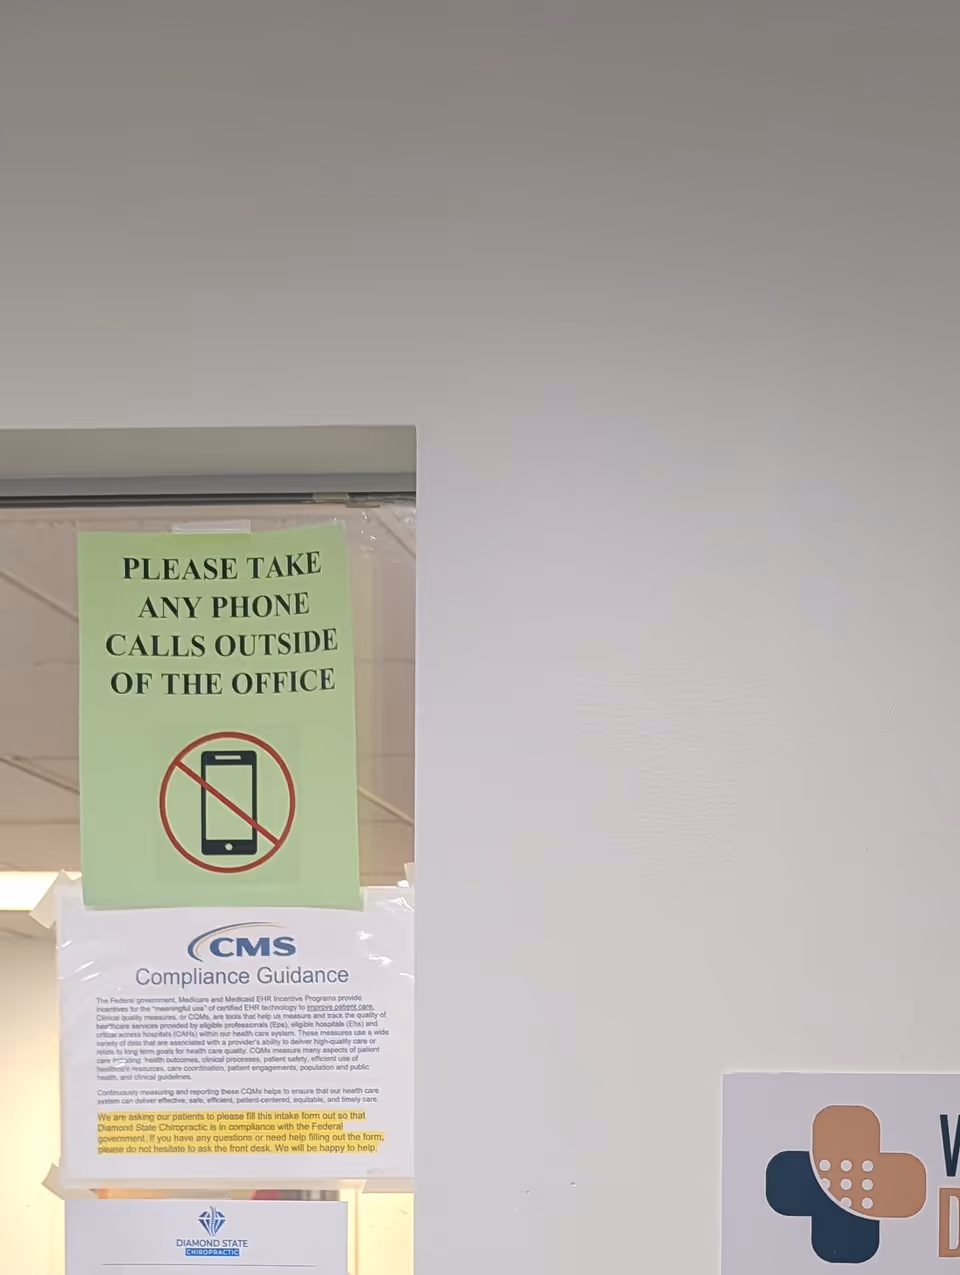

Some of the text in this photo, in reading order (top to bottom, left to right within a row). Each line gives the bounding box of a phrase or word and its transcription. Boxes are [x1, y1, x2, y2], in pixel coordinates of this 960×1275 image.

[122, 551, 322, 580] PLEASE TAKE
[138, 592, 310, 618] ANY PHONE
[106, 628, 338, 657] CALLS OUTSIDE
[110, 668, 336, 695] OF THE OFFICE
[209, 936, 296, 958] CMS
[136, 966, 349, 989] Compliance Guidance
[98, 1113, 111, 1121] We
[128, 1112, 154, 1122] asking
[172, 1112, 204, 1122] patients
[206, 1112, 214, 1120] to
[216, 1112, 244, 1122] please
[246, 1112, 255, 1120] fill
[257, 1112, 272, 1120] this
[274, 1112, 299, 1120] intake
[301, 1111, 320, 1120] form
[322, 1111, 335, 1120] out
[349, 1111, 365, 1120] that
[98, 1122, 343, 1133] Diamond State Chiropractic is in compliance with the Federal
[98, 1145, 124, 1154] please
[126, 1144, 136, 1153] do
[138, 1144, 151, 1153] not
[153, 1144, 185, 1153] hesitate
[187, 1144, 195, 1153] to
[197, 1144, 212, 1153] ask
[214, 1144, 227, 1152] the
[229, 1144, 248, 1152] front
[274, 1144, 288, 1152] We
[291, 1144, 304, 1152] will
[306, 1144, 317, 1152] be
[319, 1144, 344, 1153] happy
[347, 1143, 355, 1152] to
[149, 1133, 154, 1142] If
[157, 1135, 171, 1143] you
[173, 1133, 193, 1142] have
[195, 1135, 210, 1143] any
[213, 1133, 252, 1143] questions
[265, 1133, 286, 1141] need
[288, 1133, 306, 1143] help
[308, 1133, 330, 1143] filling
[332, 1133, 345, 1141] out
[347, 1132, 360, 1141] the
[362, 1132, 384, 1142] form,
[176, 1238, 248, 1248] DIAMOND STATE
